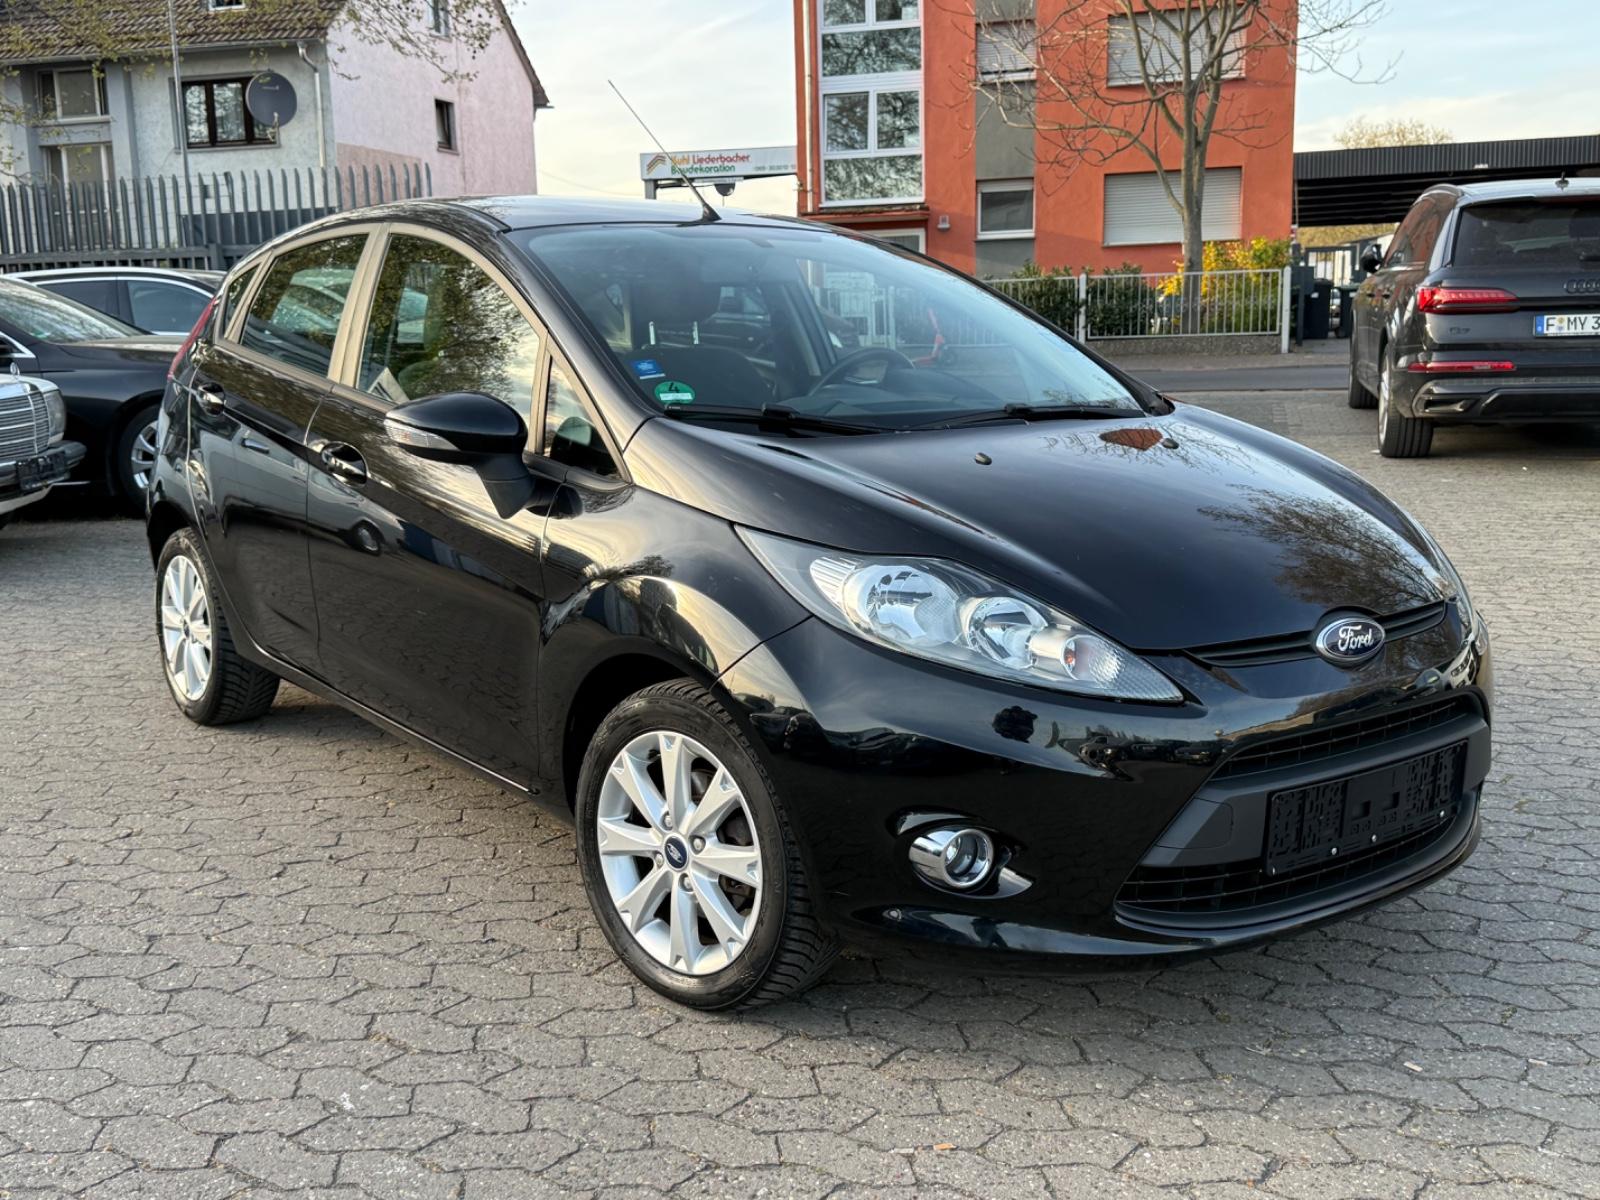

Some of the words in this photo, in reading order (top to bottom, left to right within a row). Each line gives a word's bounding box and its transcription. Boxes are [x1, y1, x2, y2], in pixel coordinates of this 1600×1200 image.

[693, 153, 750, 164] Liederbacher
[1546, 317, 1556, 331] F
[1567, 316, 1588, 331] MY
[668, 382, 680, 393] 4
[1338, 625, 1374, 652] Ford
